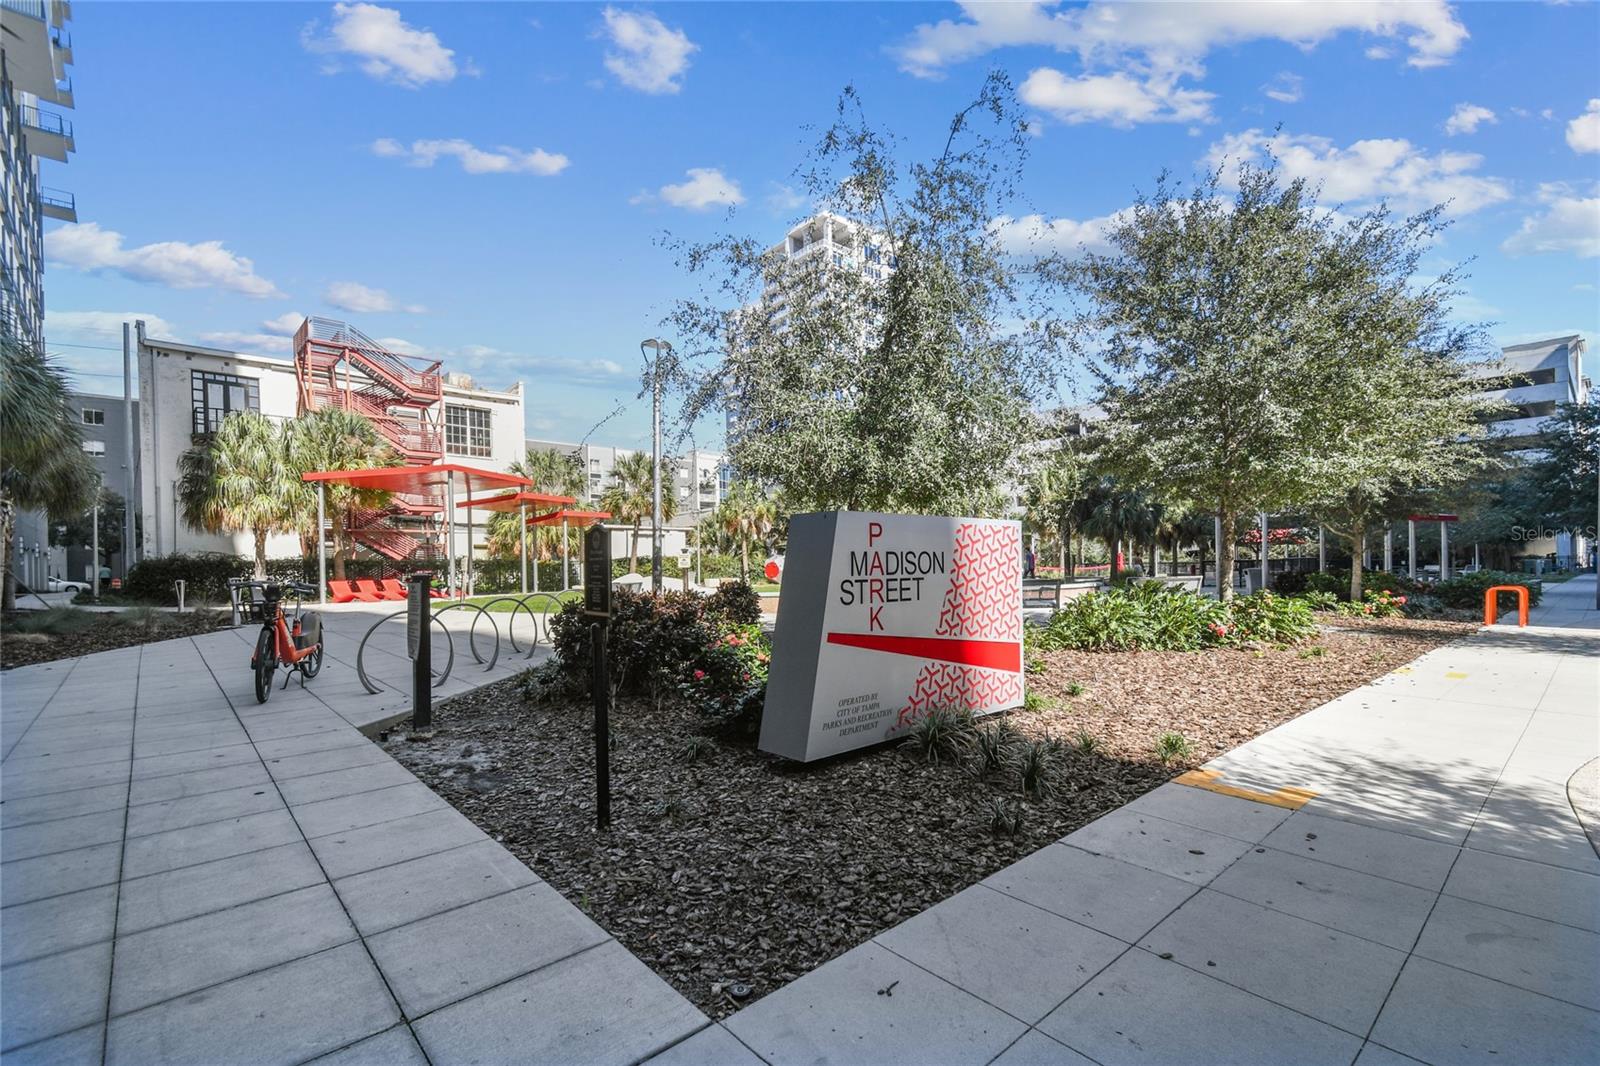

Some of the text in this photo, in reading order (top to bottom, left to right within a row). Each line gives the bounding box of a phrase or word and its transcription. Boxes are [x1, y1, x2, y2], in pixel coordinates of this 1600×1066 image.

[850, 551, 945, 577] MADISON
[869, 522, 884, 632] PARK
[840, 577, 924, 606] STREET
[836, 702, 880, 718] CITY OF TAMPA
[838, 692, 878, 707] OPERATED BY
[822, 709, 893, 731] PARKS AND RECREATION
[839, 721, 878, 737] DEPARTMENT
